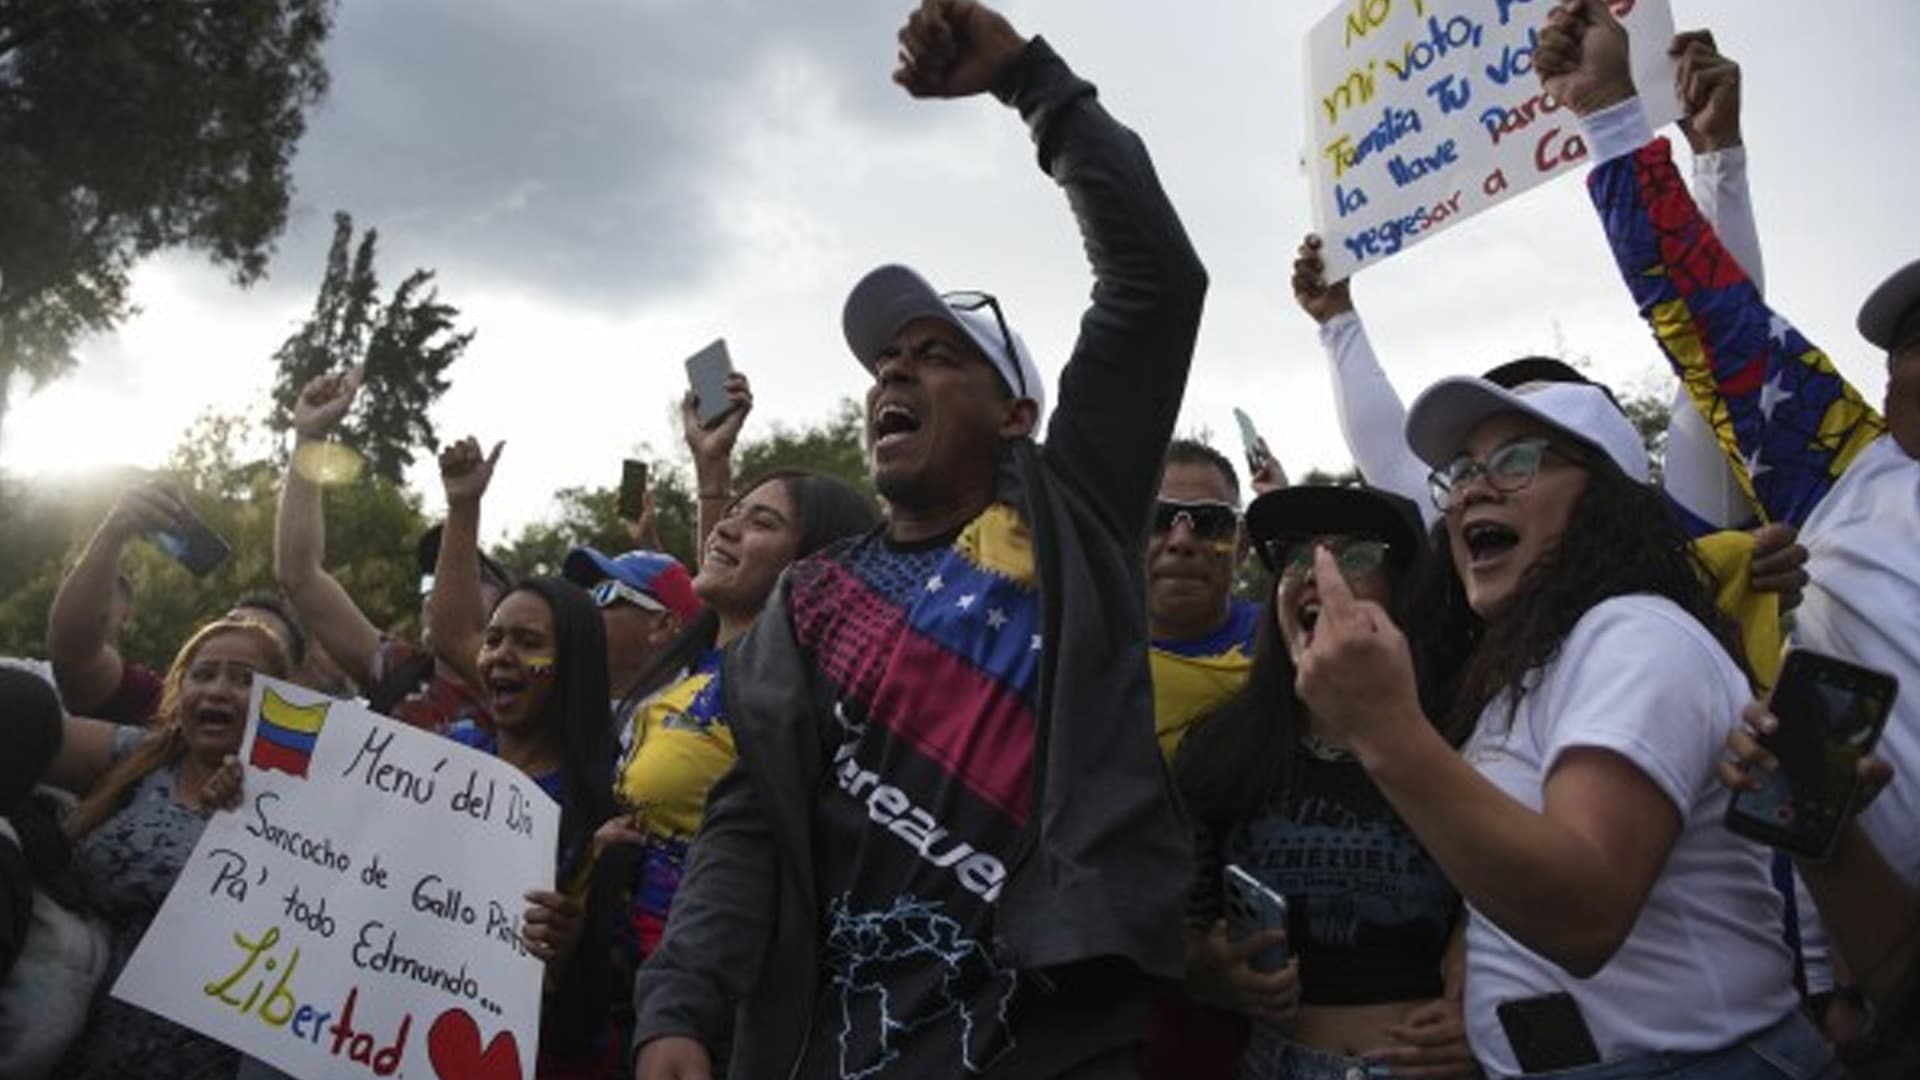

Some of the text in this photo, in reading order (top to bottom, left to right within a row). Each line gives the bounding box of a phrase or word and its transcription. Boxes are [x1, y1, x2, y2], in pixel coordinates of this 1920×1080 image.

[1322, 58, 1377, 125] mi
[1334, 183, 1368, 218] la
[1344, 189, 1462, 261] regresar
[1483, 167, 1508, 196] a
[342, 726, 448, 805] Menú
[451, 769, 496, 821] del
[283, 885, 336, 939] todo
[361, 855, 388, 890] de
[411, 874, 476, 925] Gallo
